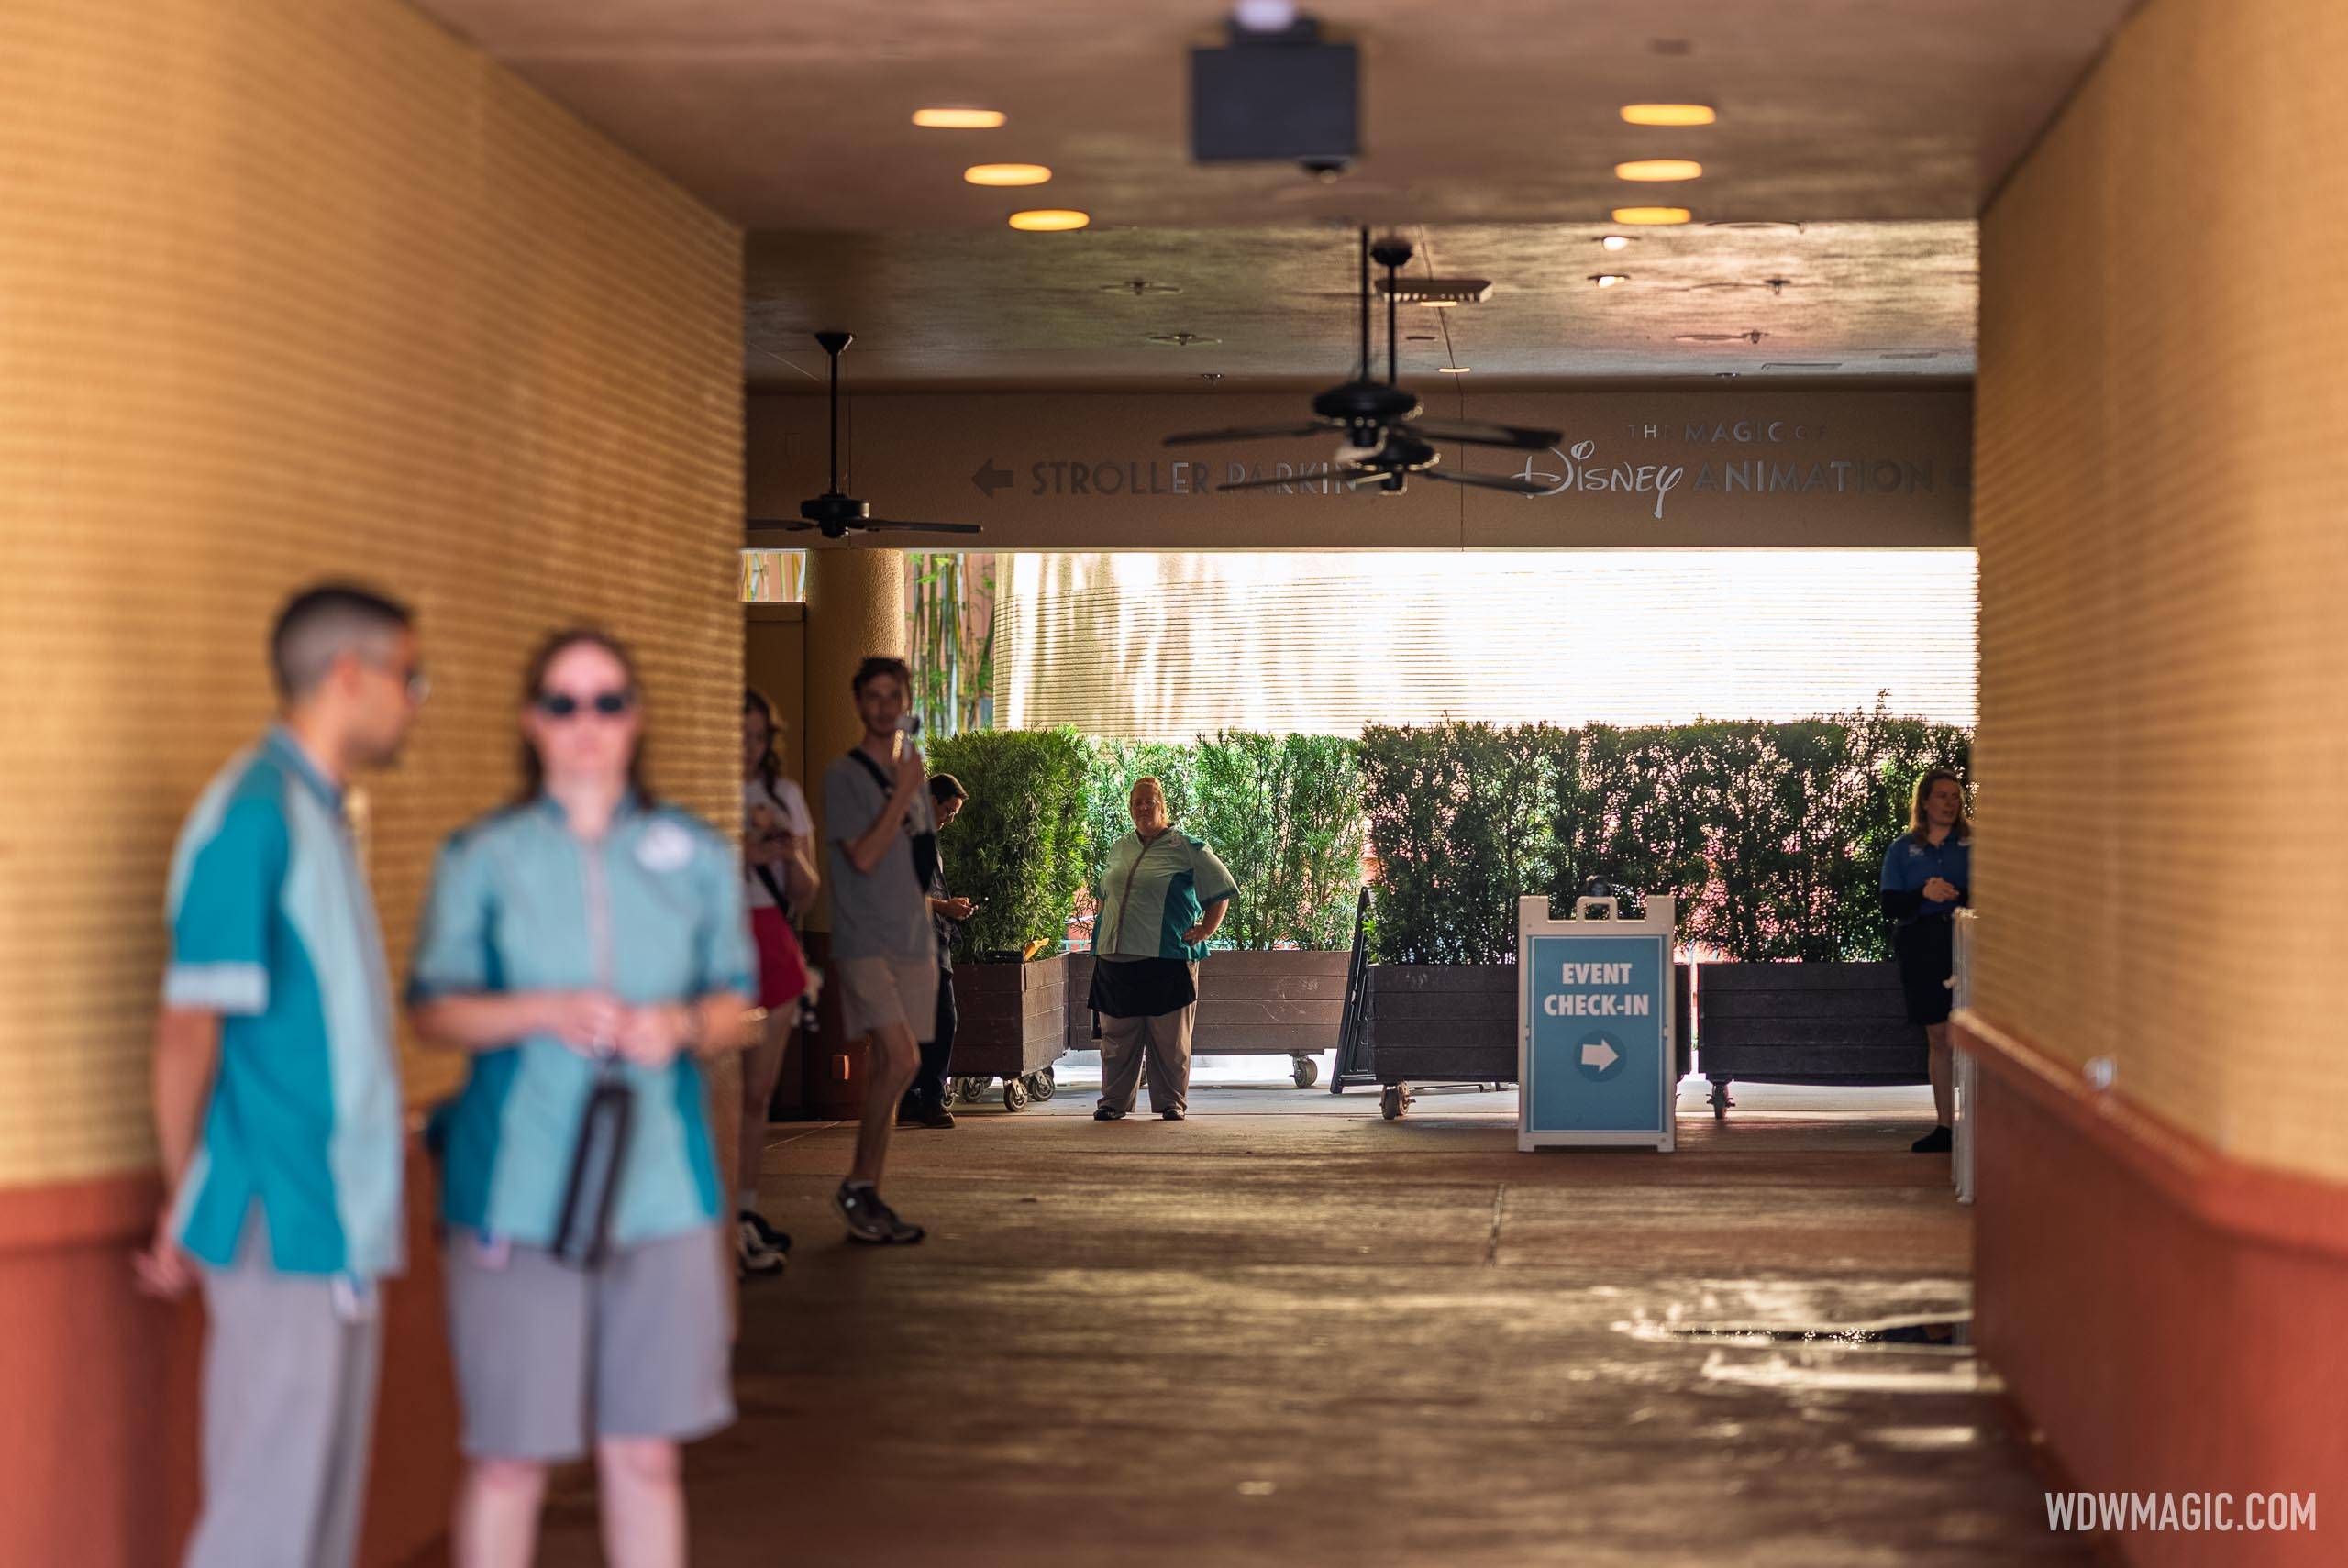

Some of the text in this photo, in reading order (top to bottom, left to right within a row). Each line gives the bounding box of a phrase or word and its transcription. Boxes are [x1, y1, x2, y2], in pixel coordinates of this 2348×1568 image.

[1684, 420, 1785, 444] MAGIC
[1032, 461, 1372, 496] STROLLER PARKIN
[1693, 460, 1934, 494] ANIMATION
[1561, 962, 1633, 985] EVENT
[1544, 994, 1649, 1017] CHECK-IN
